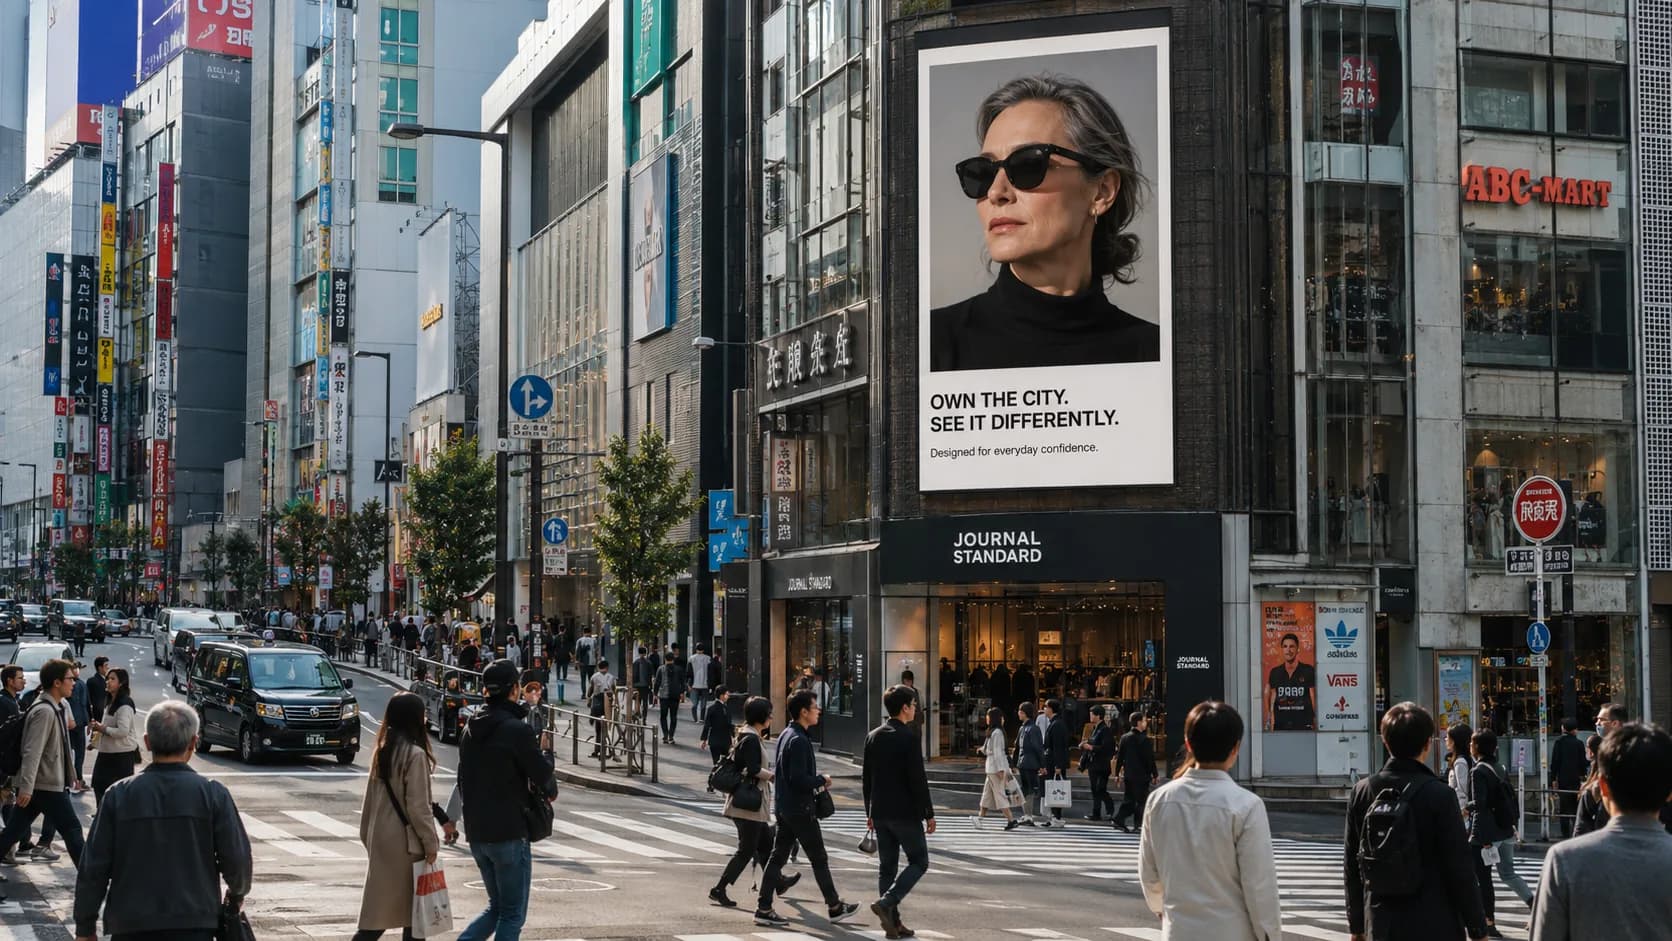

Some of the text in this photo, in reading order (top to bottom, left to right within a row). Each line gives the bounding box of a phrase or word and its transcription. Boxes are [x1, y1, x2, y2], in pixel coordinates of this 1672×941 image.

[1464, 165, 1612, 208] ABC-MART
[930, 389, 1069, 410] OWN THE CITY.
[930, 409, 1119, 432] SEE IT DIFFERENTLY.
[930, 443, 1098, 460] Designed for everyday confidence.
[953, 531, 1042, 547] JOURNAL
[953, 548, 1042, 564] STANDARD
[1326, 674, 1358, 687] VANS
